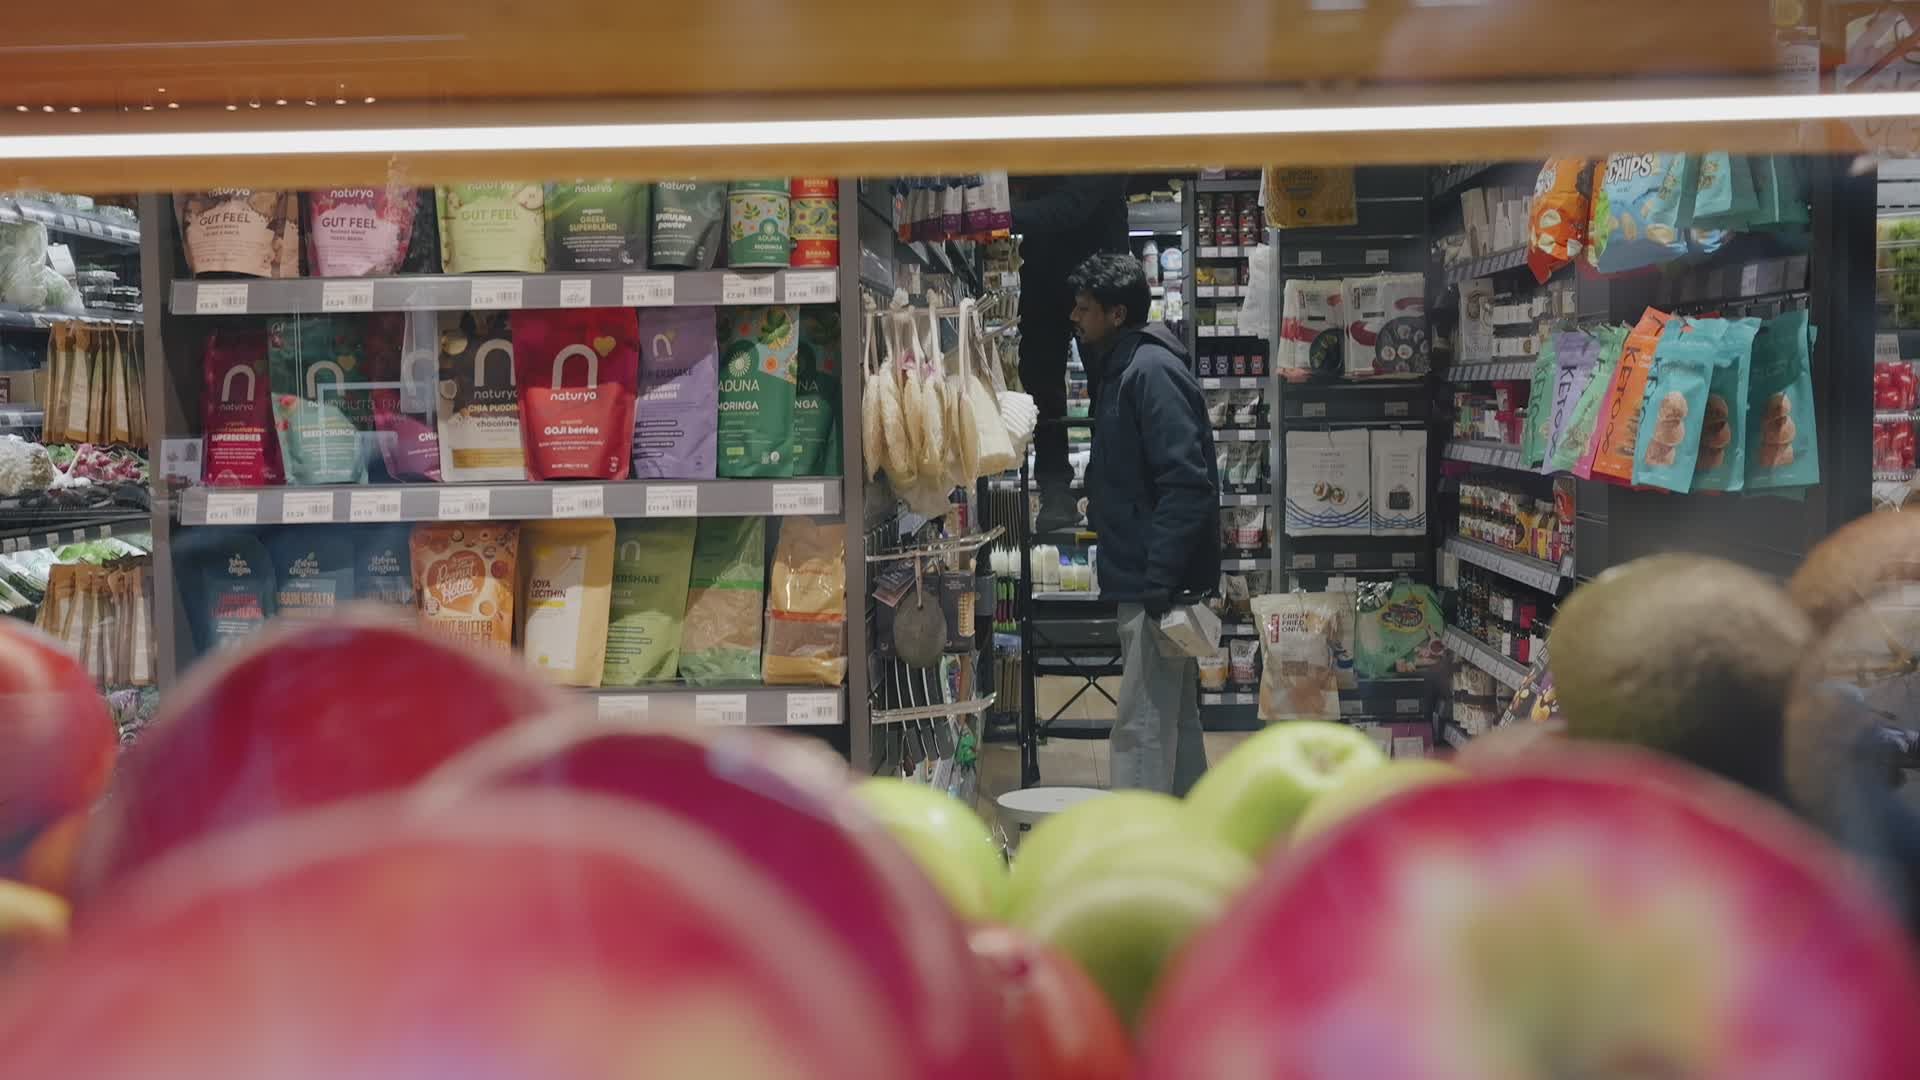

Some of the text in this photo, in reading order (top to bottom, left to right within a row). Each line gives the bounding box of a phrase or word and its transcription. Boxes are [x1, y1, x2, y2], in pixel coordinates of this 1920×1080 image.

[1606, 152, 1654, 185] CHIPS
[330, 187, 374, 199] naturya
[199, 212, 251, 226] GUT FEEL
[321, 217, 377, 229] GUT FEEL
[717, 379, 760, 392] ADUNA
[550, 391, 597, 402] naturya
[468, 404, 488, 412] CHIA
[544, 425, 599, 435] GOJI berries
[458, 619, 493, 632] BUTTER
